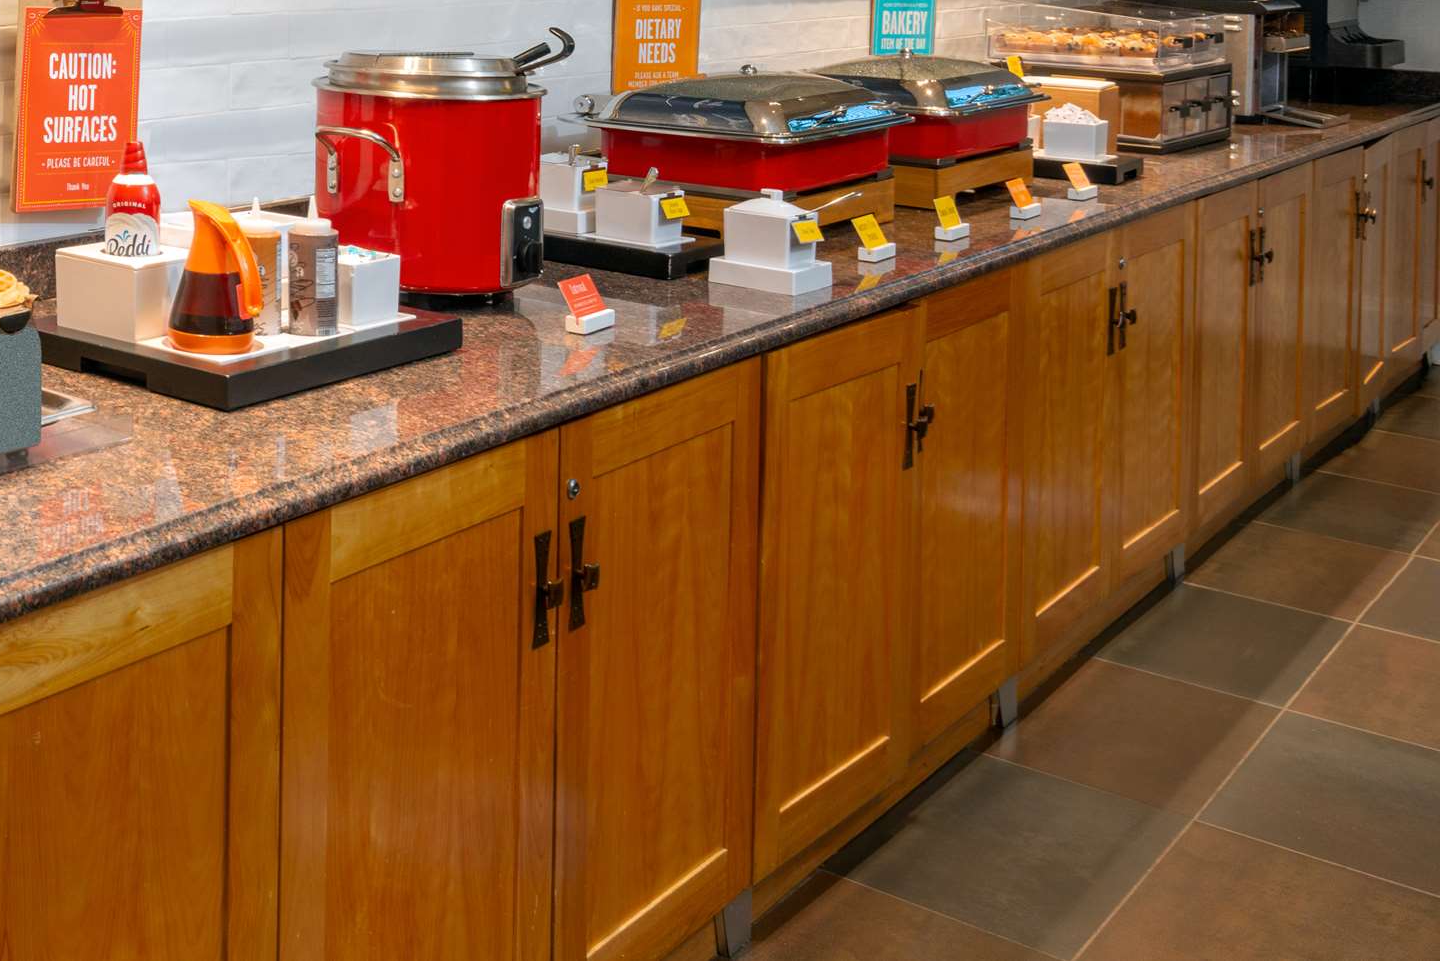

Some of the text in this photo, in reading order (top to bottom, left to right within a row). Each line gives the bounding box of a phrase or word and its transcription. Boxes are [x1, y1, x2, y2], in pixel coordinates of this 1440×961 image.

[635, 18, 682, 40] DIETARY
[882, 10, 928, 35] BAKERY
[638, 42, 676, 64] NEEDS
[48, 52, 117, 80] CAUTION:
[68, 84, 97, 112] HOT
[43, 115, 117, 144] SURFACES
[46, 155, 110, 169] PLEASE BE CAREFUL
[112, 200, 147, 210] ORIGINAL
